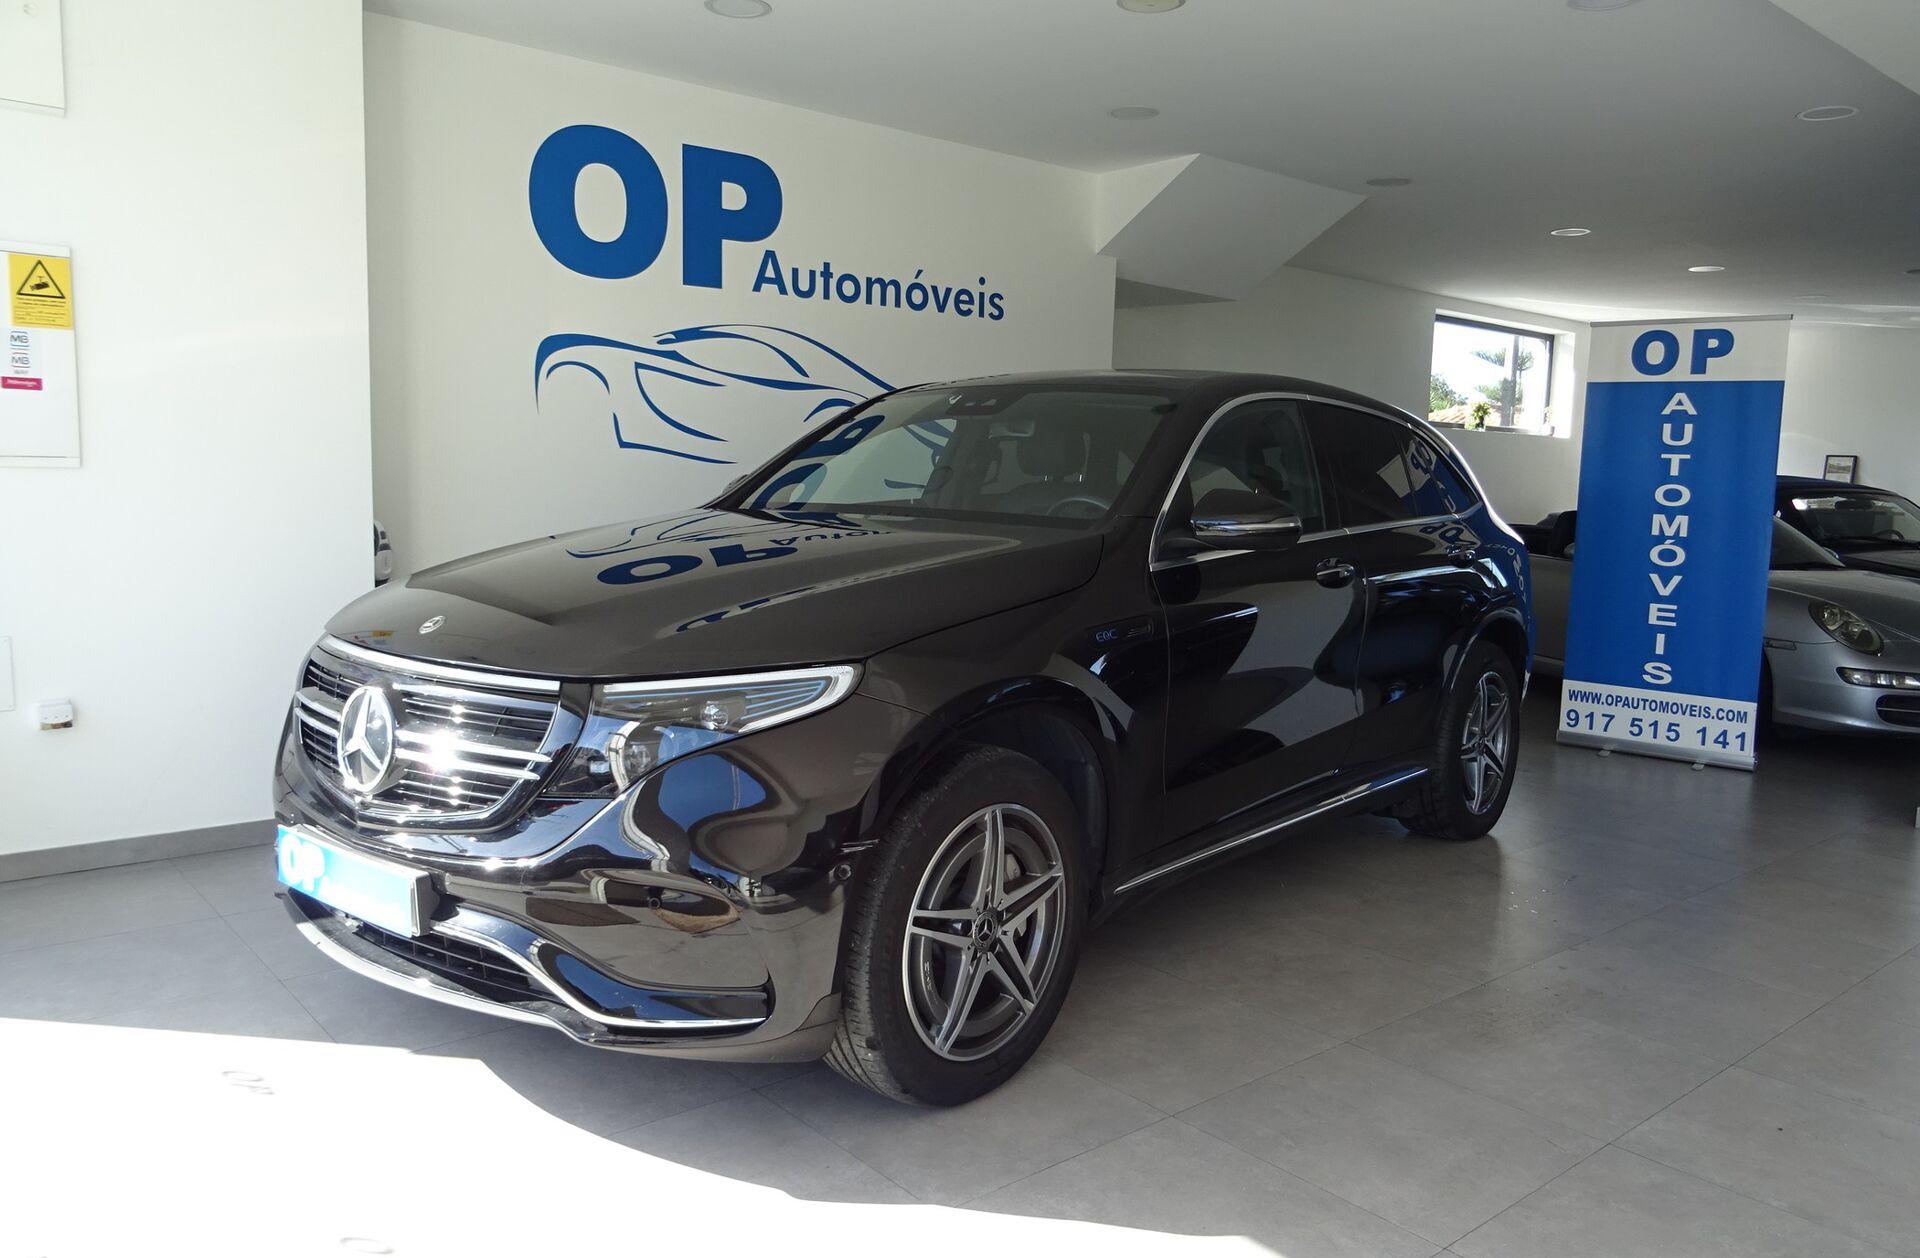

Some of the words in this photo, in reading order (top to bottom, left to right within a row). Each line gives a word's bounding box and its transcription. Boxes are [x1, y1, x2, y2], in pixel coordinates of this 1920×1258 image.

[528, 124, 783, 289] OP
[752, 249, 1005, 322] Automóveis
[1631, 328, 1734, 376] OP
[1642, 392, 1698, 685] AUTOMÓVEIS
[1096, 629, 1117, 641] EQC
[1565, 708, 1616, 733] 917
[1628, 717, 1681, 743] 515
[1696, 725, 1747, 752] 141
[1567, 688, 1748, 724] WWW.OPAUTOMOVEIS.COM
